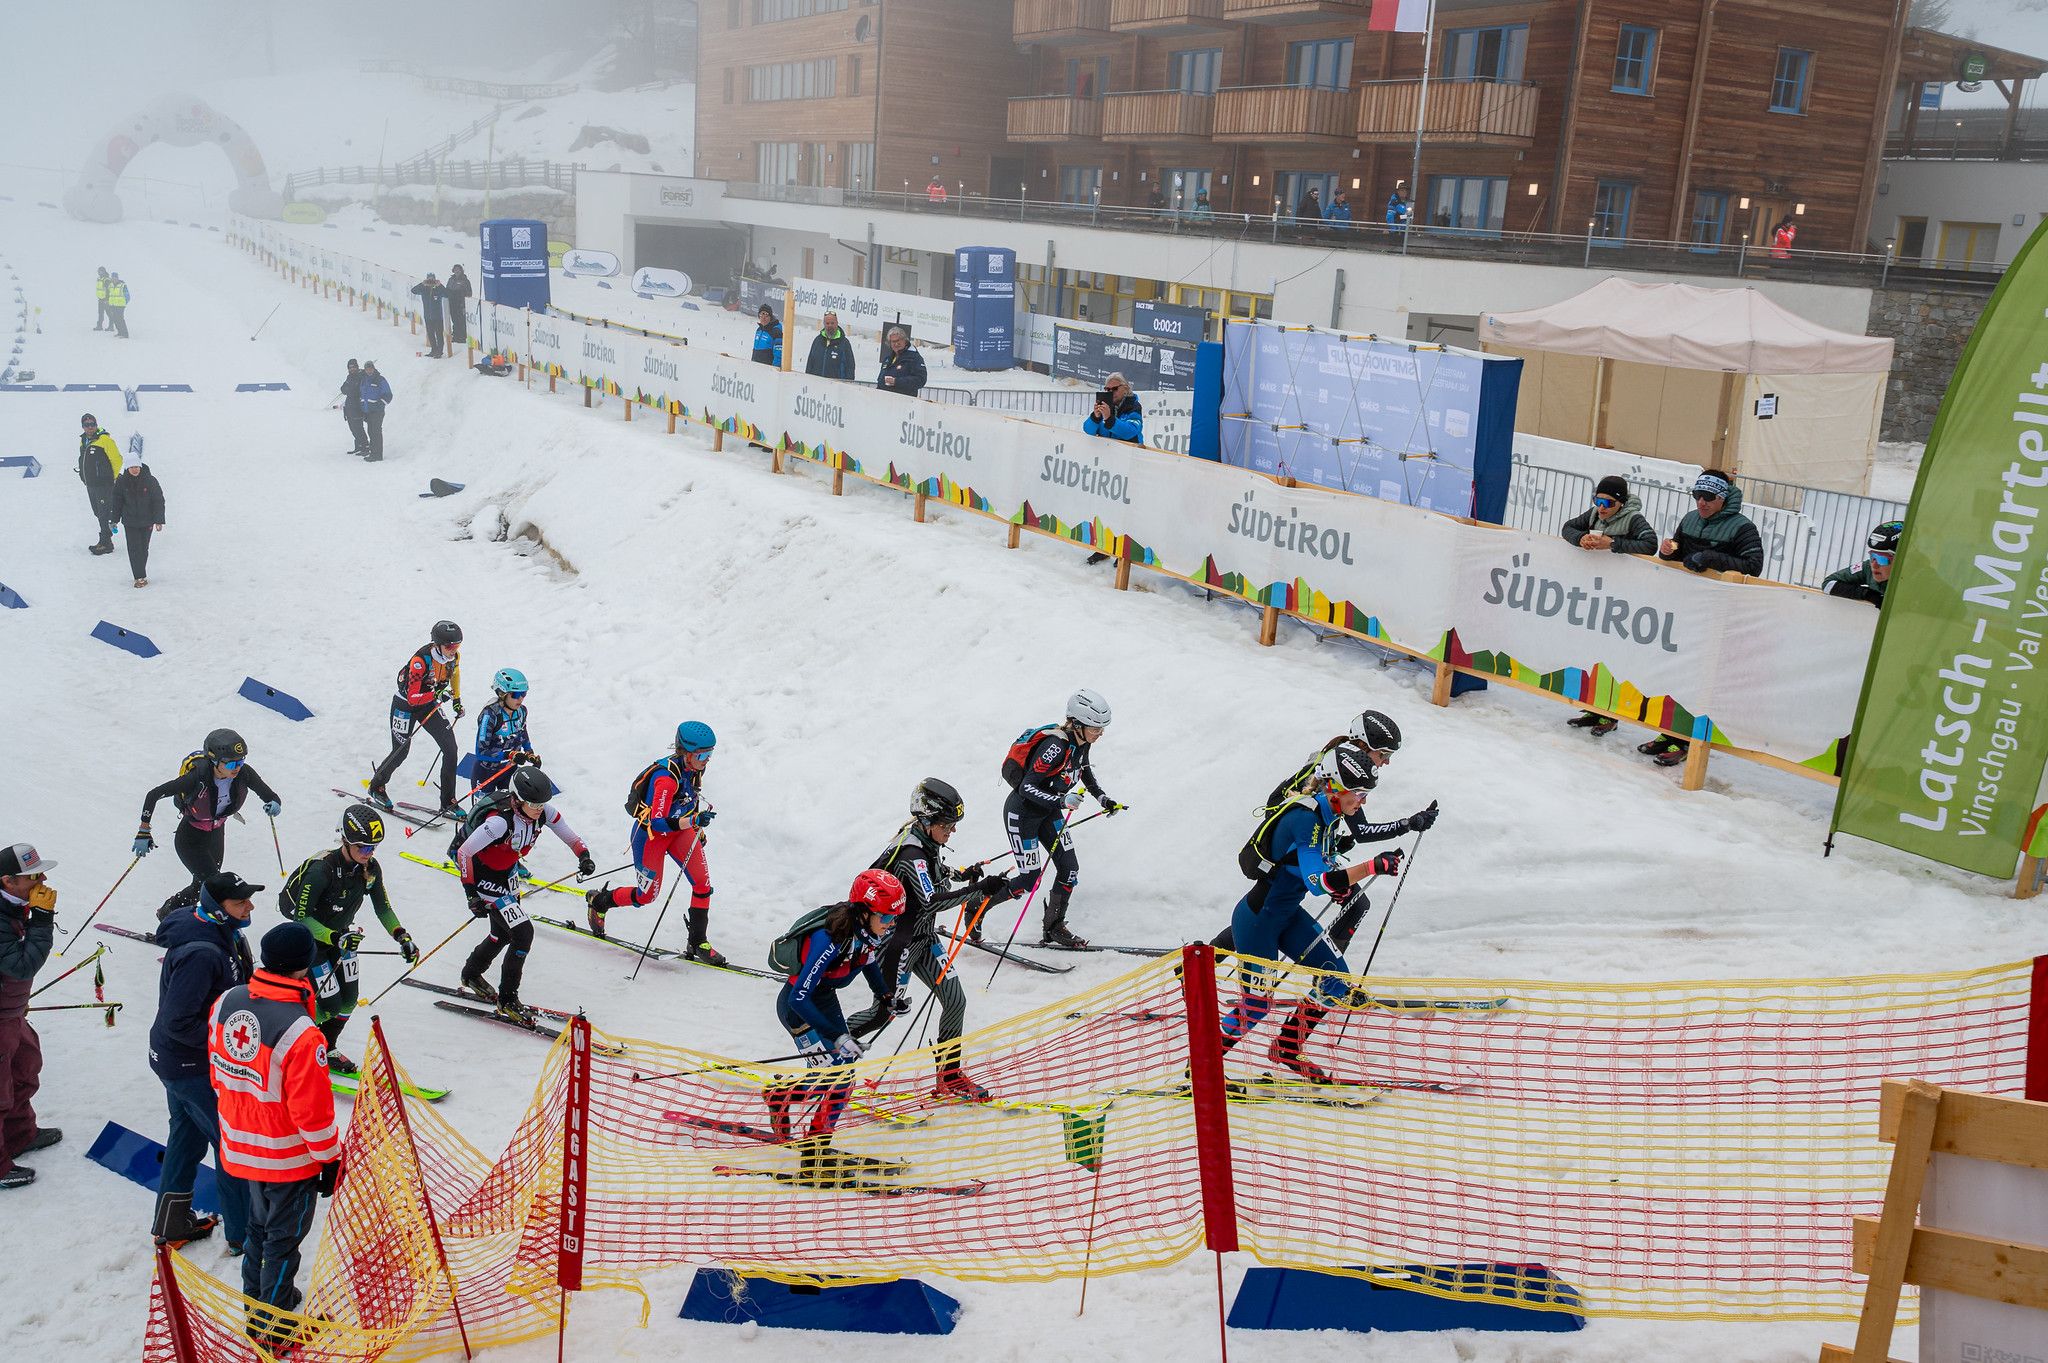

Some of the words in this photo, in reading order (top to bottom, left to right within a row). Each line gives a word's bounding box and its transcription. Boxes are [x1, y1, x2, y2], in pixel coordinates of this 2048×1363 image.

[513, 240, 531, 248] ISMF
[821, 291, 847, 313] alperia
[850, 295, 878, 318] alperia
[1153, 318, 1182, 334] 0:00:21
[1900, 654, 1993, 832] Latsch
[1963, 306, 2048, 610] Martellt
[393, 717, 408, 731] 25.1
[1958, 698, 2022, 836] Vinschgau
[2005, 627, 2043, 671] Val
[1340, 752, 1369, 779] DYNAFIT
[503, 905, 525, 924] 28.1
[796, 989, 807, 1001] LA
[229, 1014, 258, 1039] DEUTSCHES
[213, 1055, 261, 1083] Sanitätsdienst
[564, 1238, 576, 1250] 19
